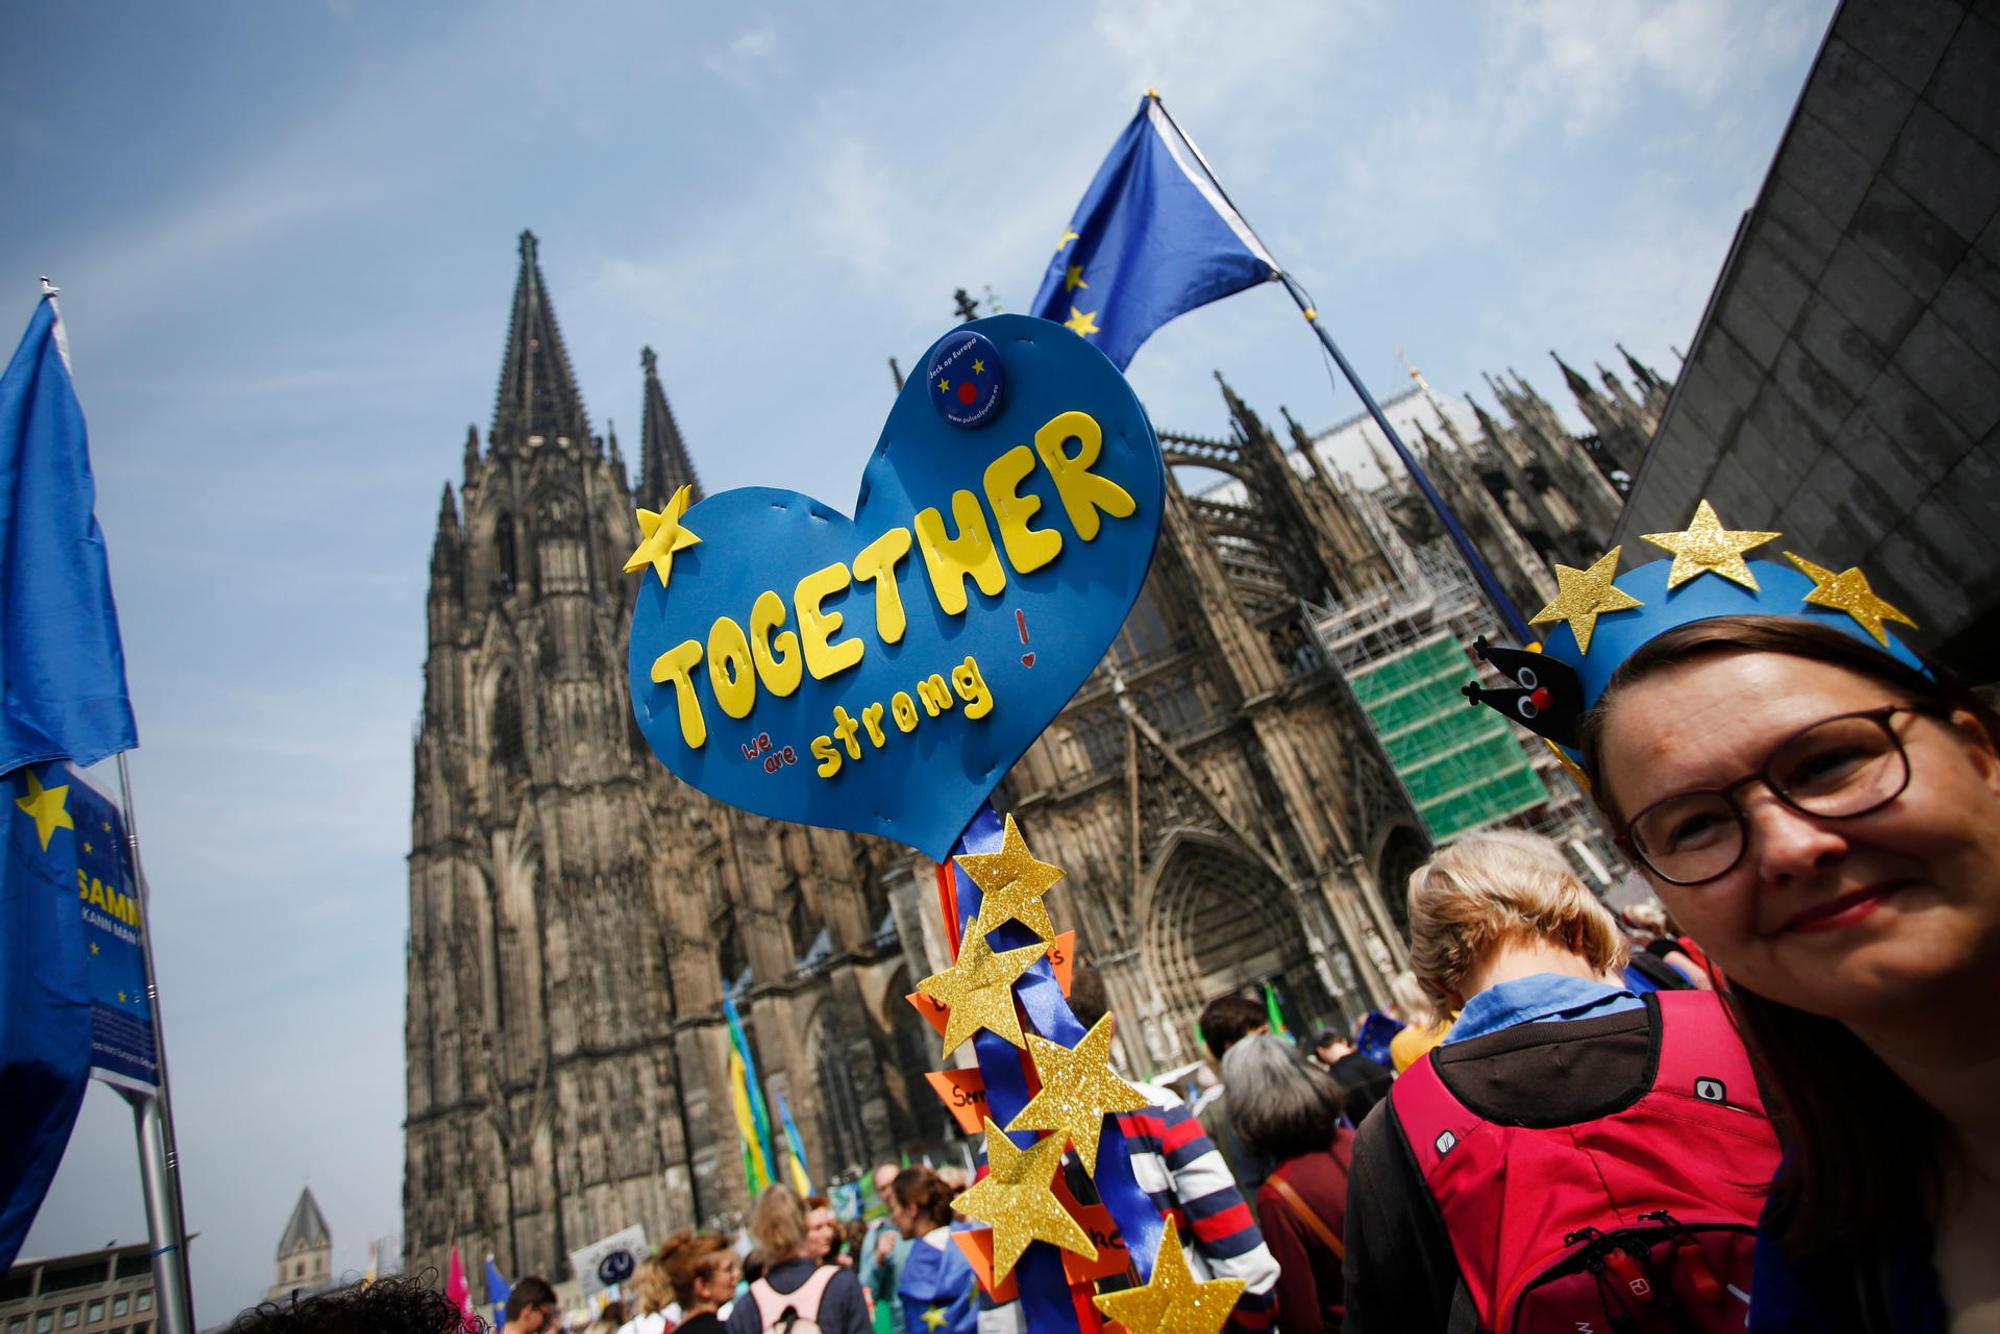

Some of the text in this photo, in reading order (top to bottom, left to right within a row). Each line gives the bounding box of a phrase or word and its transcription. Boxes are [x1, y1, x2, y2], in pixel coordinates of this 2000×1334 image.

[929, 337, 977, 380] Jeck op Europa
[651, 411, 1136, 749] TOGETHER
[740, 731, 773, 761] we
[763, 745, 798, 774] are
[810, 655, 994, 779] strong
[113, 923, 137, 945] MAN
